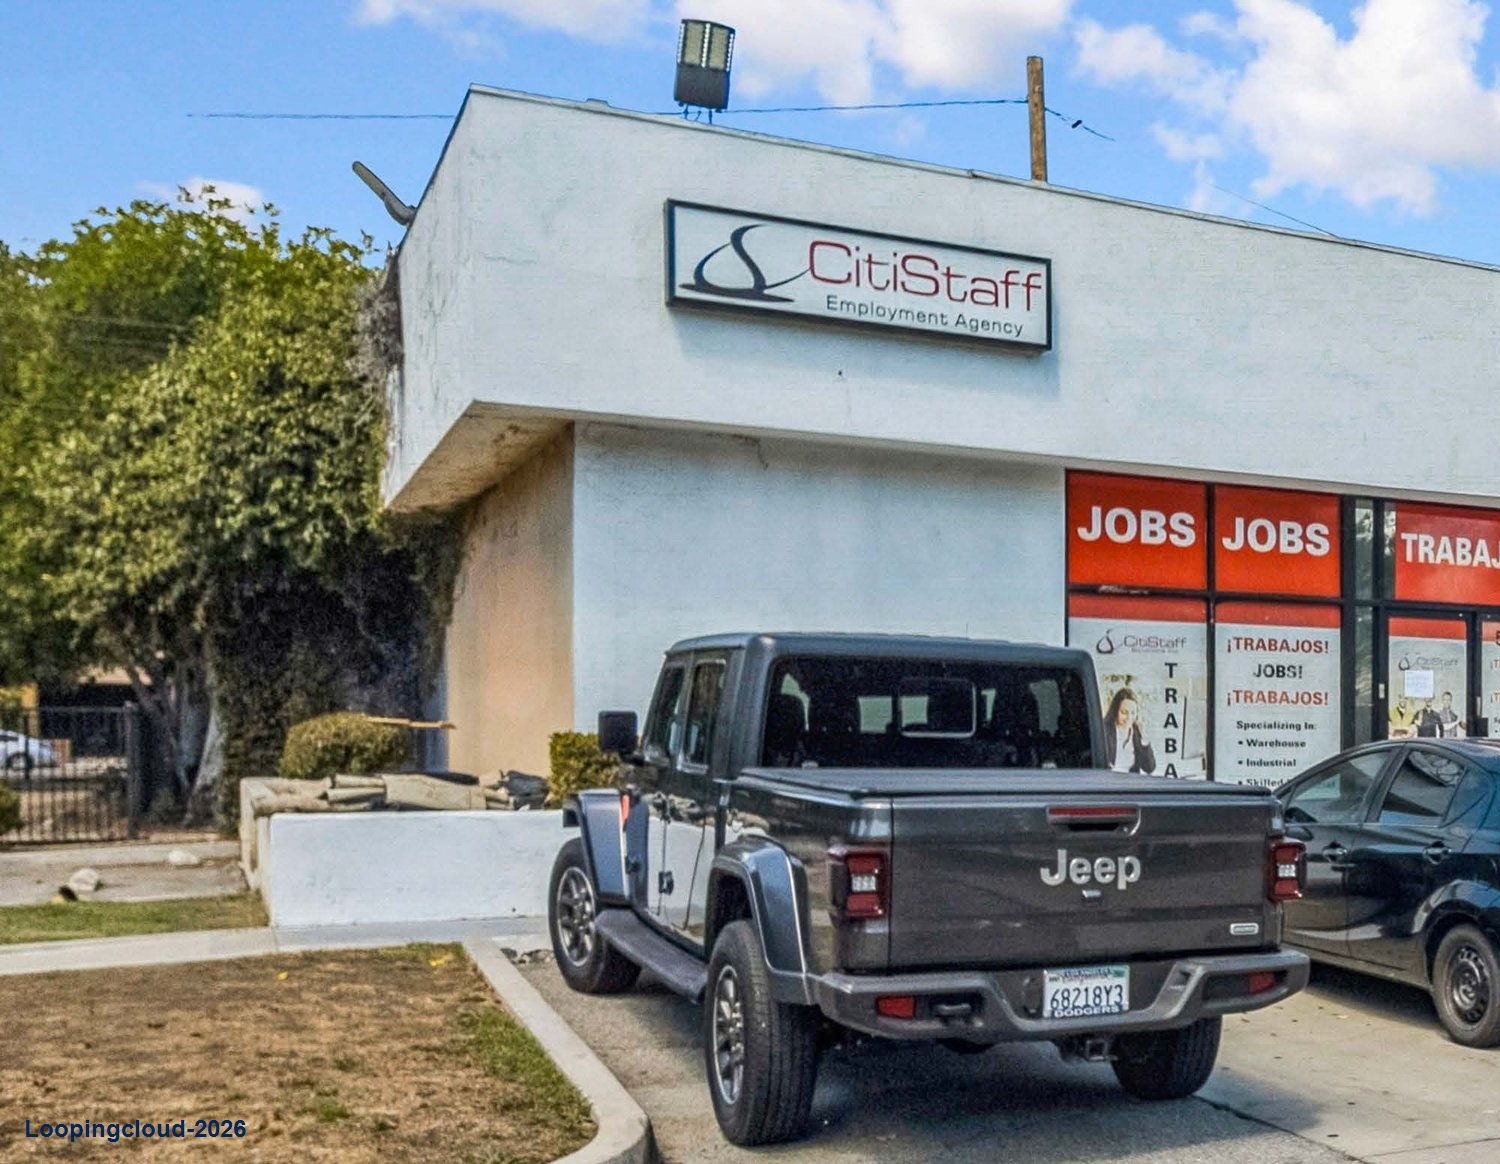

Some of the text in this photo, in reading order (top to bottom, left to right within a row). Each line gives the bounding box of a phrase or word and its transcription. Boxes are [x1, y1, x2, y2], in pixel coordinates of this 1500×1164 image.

[809, 240, 1042, 312] CitiStaff
[826, 295, 1023, 338] Employment Agency
[1076, 505, 1196, 548] JOBS
[1222, 517, 1330, 557] JOBS
[1124, 635, 1187, 648] CitiStaff
[1227, 637, 1329, 654] ¡TRABAJOS!
[1253, 664, 1303, 679] JOBS!
[1227, 690, 1328, 706] ¡TRABAJOS!
[1236, 721, 1318, 731] Specializing In:
[1246, 739, 1306, 748] Warehouse
[1246, 758, 1296, 767] Industrial
[1041, 849, 1141, 890] Jeep
[1051, 984, 1123, 1010] 68218Y3
[1054, 1006, 1119, 1018] DODGERS
